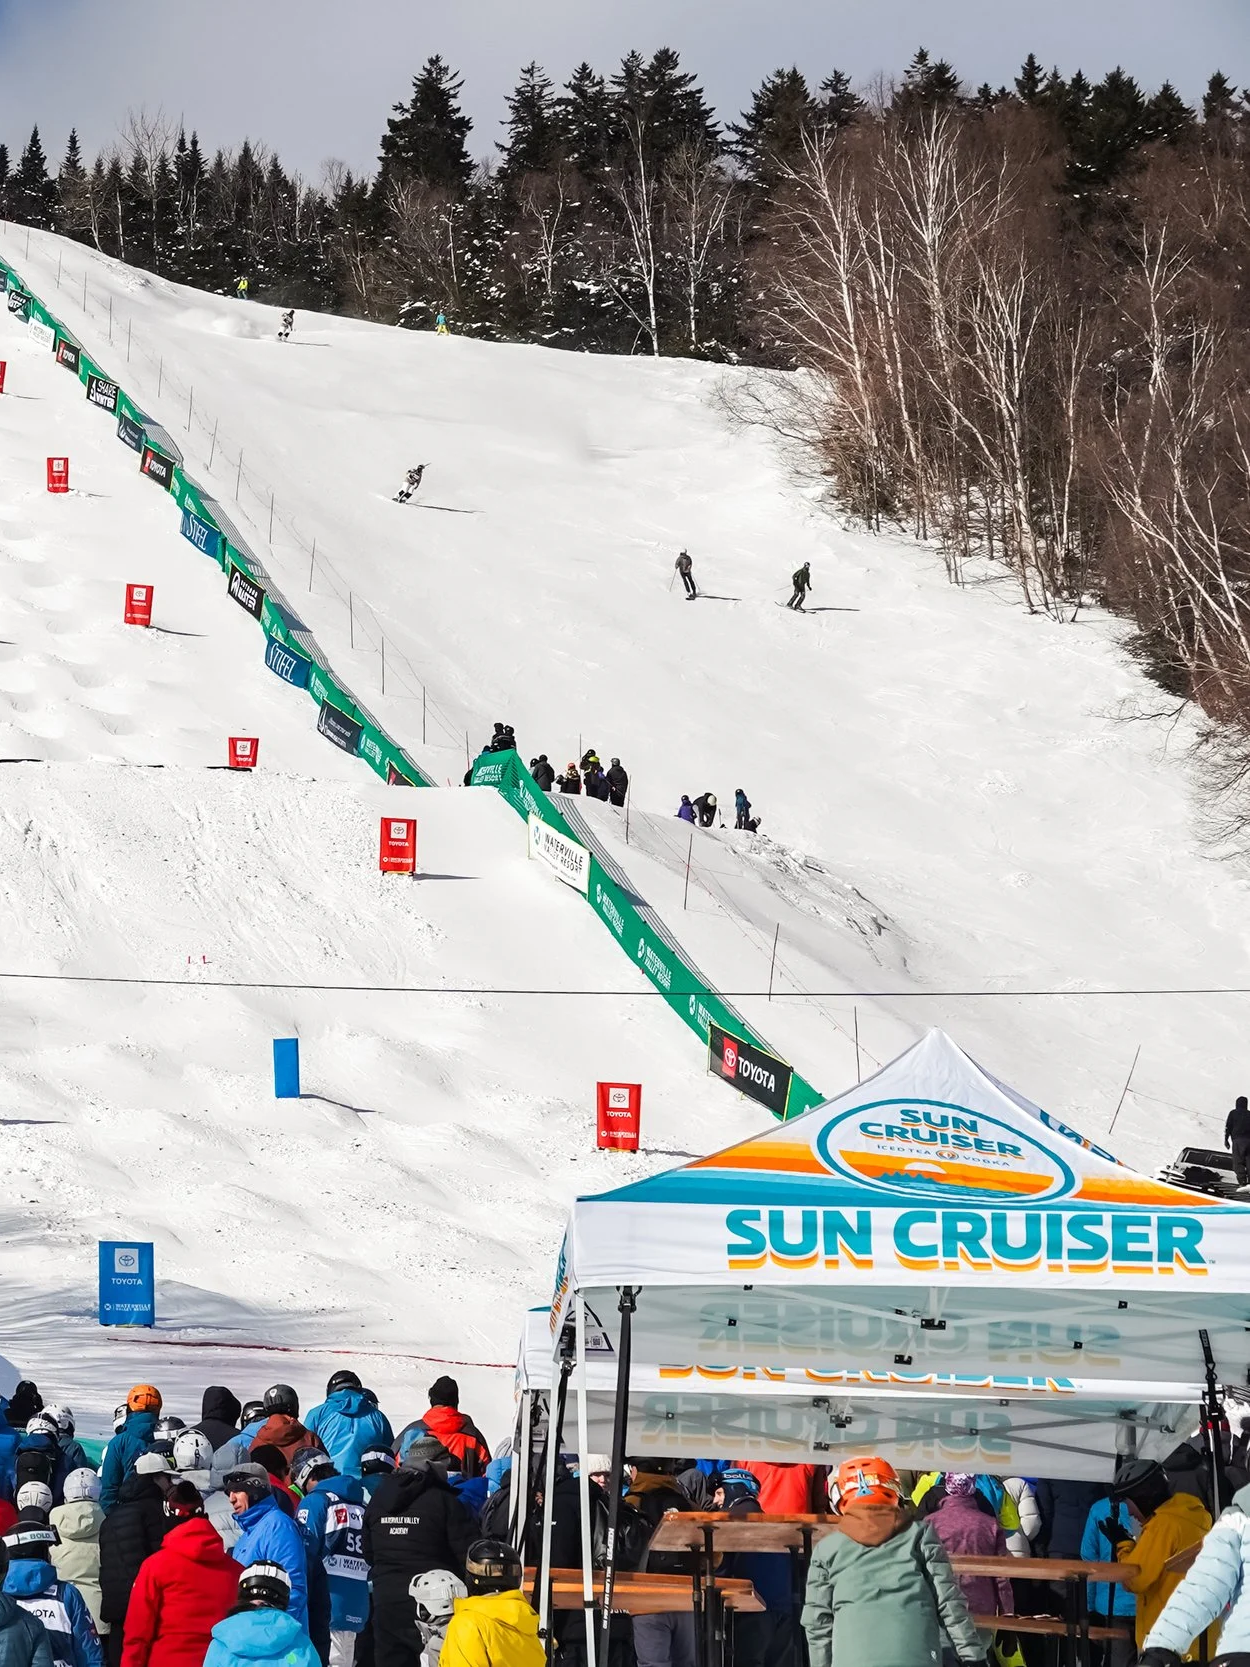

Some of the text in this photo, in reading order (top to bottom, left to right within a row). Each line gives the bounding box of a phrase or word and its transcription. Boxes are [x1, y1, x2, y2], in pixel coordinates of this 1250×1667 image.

[97, 380, 116, 399] SHARE
[266, 642, 297, 682] STIFEL
[545, 832, 584, 867] WATERVILLE
[560, 855, 582, 874] RESORT
[738, 1056, 776, 1092] TOYOTA
[606, 1110, 633, 1118] TOYOTA
[899, 1108, 979, 1136] SUN
[859, 1121, 1025, 1160] CRUISER
[877, 1144, 906, 1152] ICED
[962, 1155, 1011, 1166] VODKA
[725, 1208, 1209, 1276] SUN CRUISER
